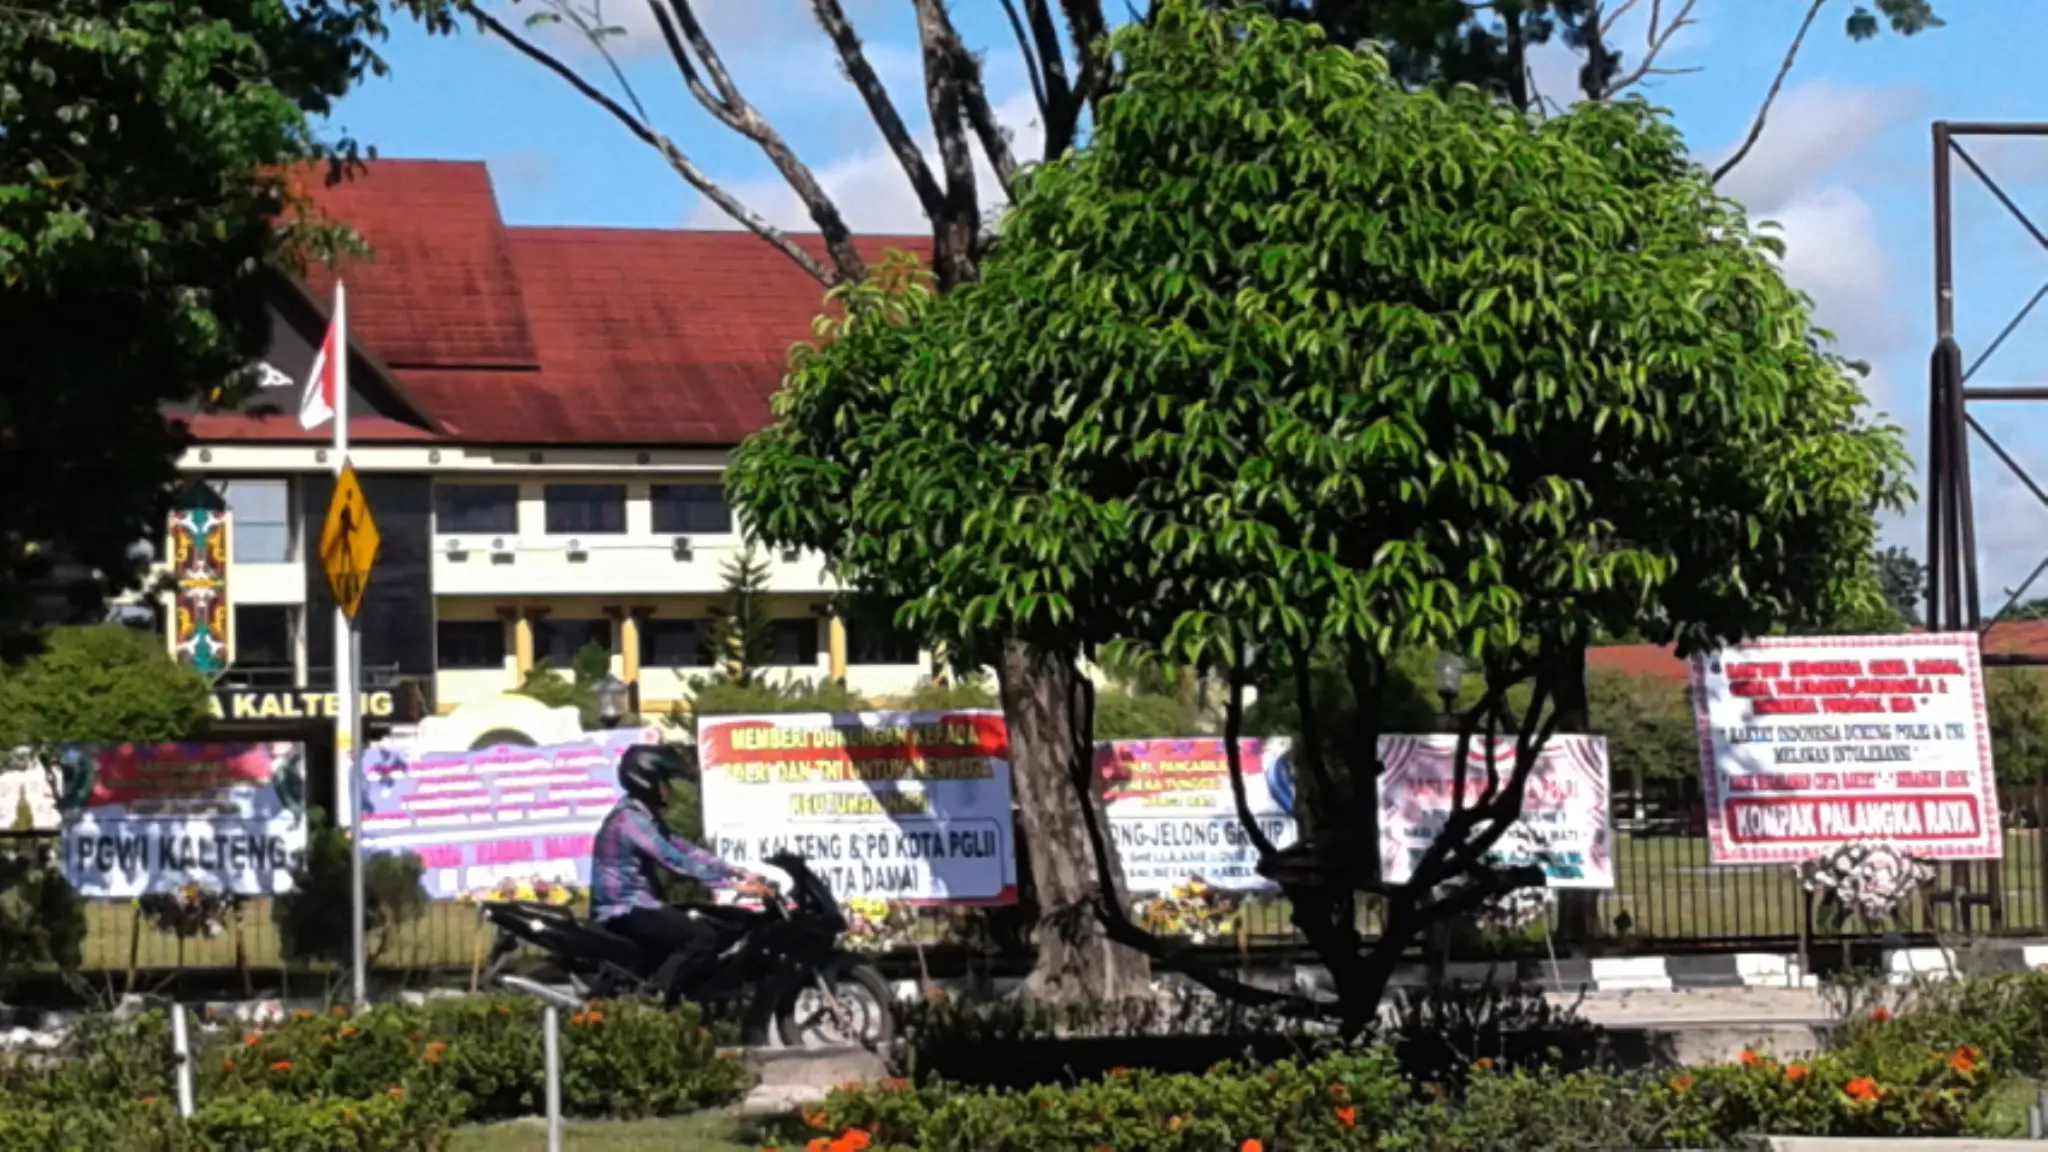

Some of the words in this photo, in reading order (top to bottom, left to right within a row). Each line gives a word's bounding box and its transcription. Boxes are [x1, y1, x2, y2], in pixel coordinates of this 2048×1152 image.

[731, 727, 808, 750] MEMBERI
[1735, 801, 1817, 837] KOMPAK
[1819, 801, 1921, 836] PALANGKA
[1923, 800, 1976, 833] RAYA
[158, 833, 287, 871] KALTENG
[849, 832, 861, 859] &
[895, 830, 946, 858] KOTA
